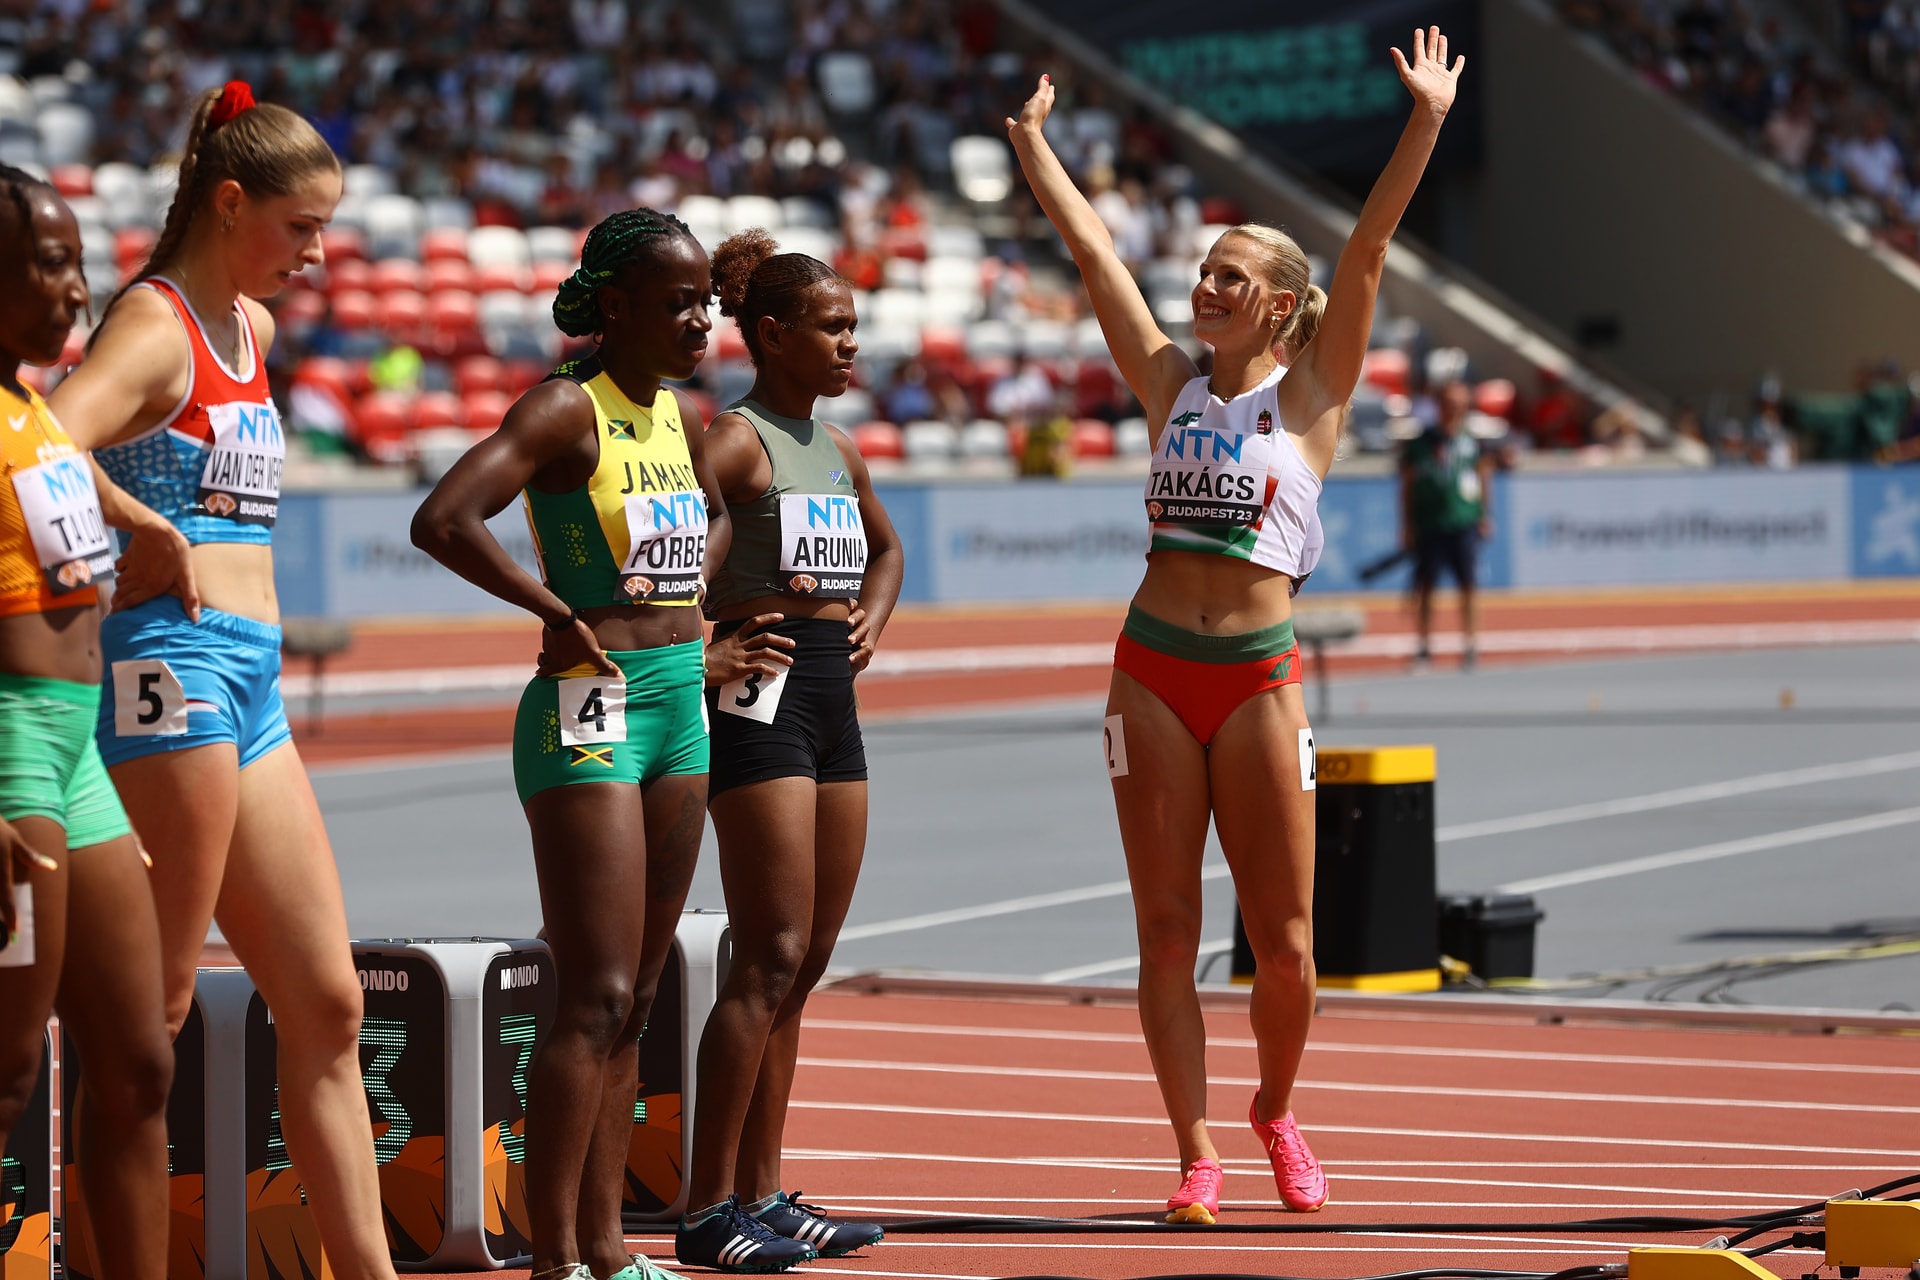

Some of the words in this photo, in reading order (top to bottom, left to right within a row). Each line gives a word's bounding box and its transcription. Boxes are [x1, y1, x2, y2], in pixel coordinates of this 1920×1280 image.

[237, 406, 279, 446] NTN
[1166, 429, 1243, 464] NTN
[210, 450, 243, 487] VAN
[245, 454, 265, 490] DER
[620, 460, 699, 494] JAMAIC
[1150, 466, 1255, 501] TAKÁCS
[239, 500, 278, 518] BUDAPES
[651, 494, 706, 532] NTN
[807, 496, 858, 530] NTN
[1167, 505, 1235, 519] BUDAPEST
[1237, 509, 1253, 521] 23
[630, 535, 704, 569] FORBE
[792, 536, 865, 568] ARUNIA
[658, 580, 698, 593] BUDAPE
[137, 673, 163, 725] 5
[735, 673, 763, 708] 3
[578, 688, 606, 732] 4
[357, 969, 409, 991] ONDO
[500, 964, 539, 990] MONDO
